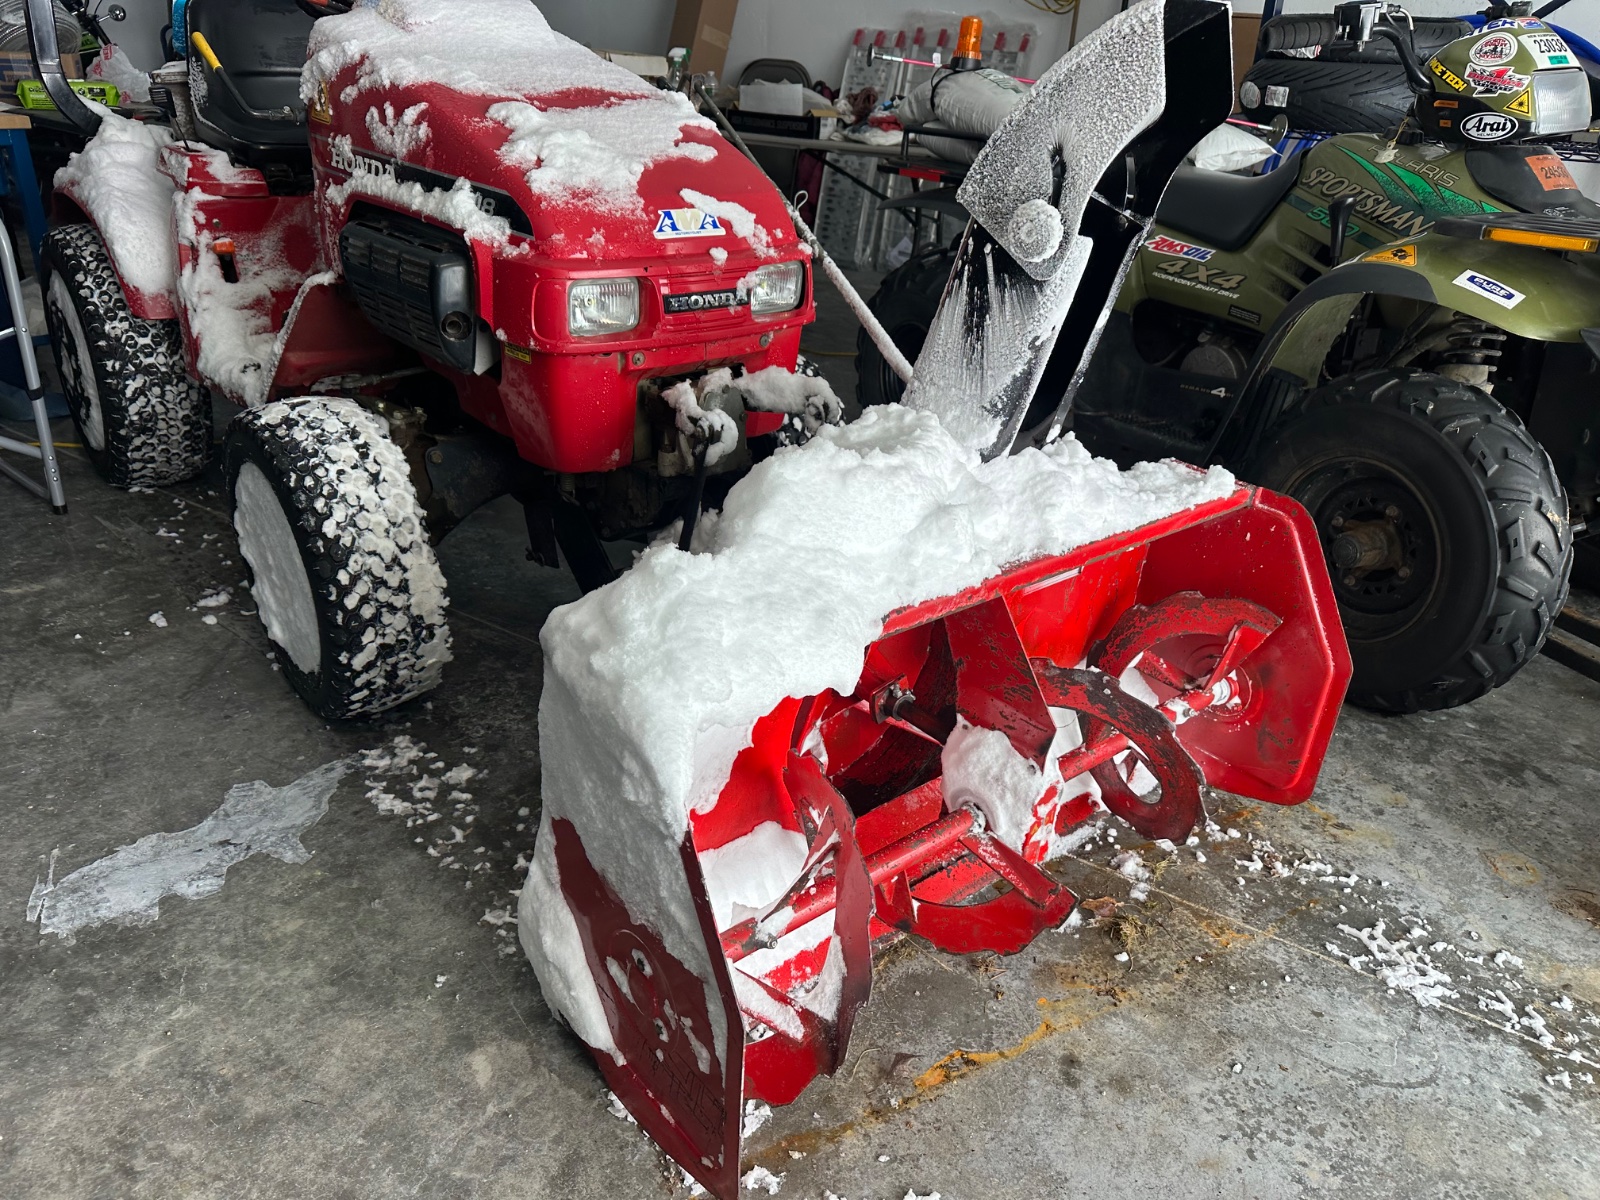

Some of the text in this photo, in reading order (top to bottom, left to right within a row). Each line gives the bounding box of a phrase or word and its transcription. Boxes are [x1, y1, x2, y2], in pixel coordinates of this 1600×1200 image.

[1533, 38, 1568, 53] 23038
[1442, 70, 1467, 92] TECH
[1466, 117, 1511, 133] Arai
[331, 150, 398, 183] HONDA
[1368, 144, 1460, 187] PLARIS
[1302, 167, 1436, 236] SPORTSMAN
[655, 210, 721, 233] AMA
[1146, 236, 1213, 261] AMSOIL
[1152, 271, 1240, 299] INDEPENDENT SHAFT DRIVE
[1210, 387, 1226, 398] 4
